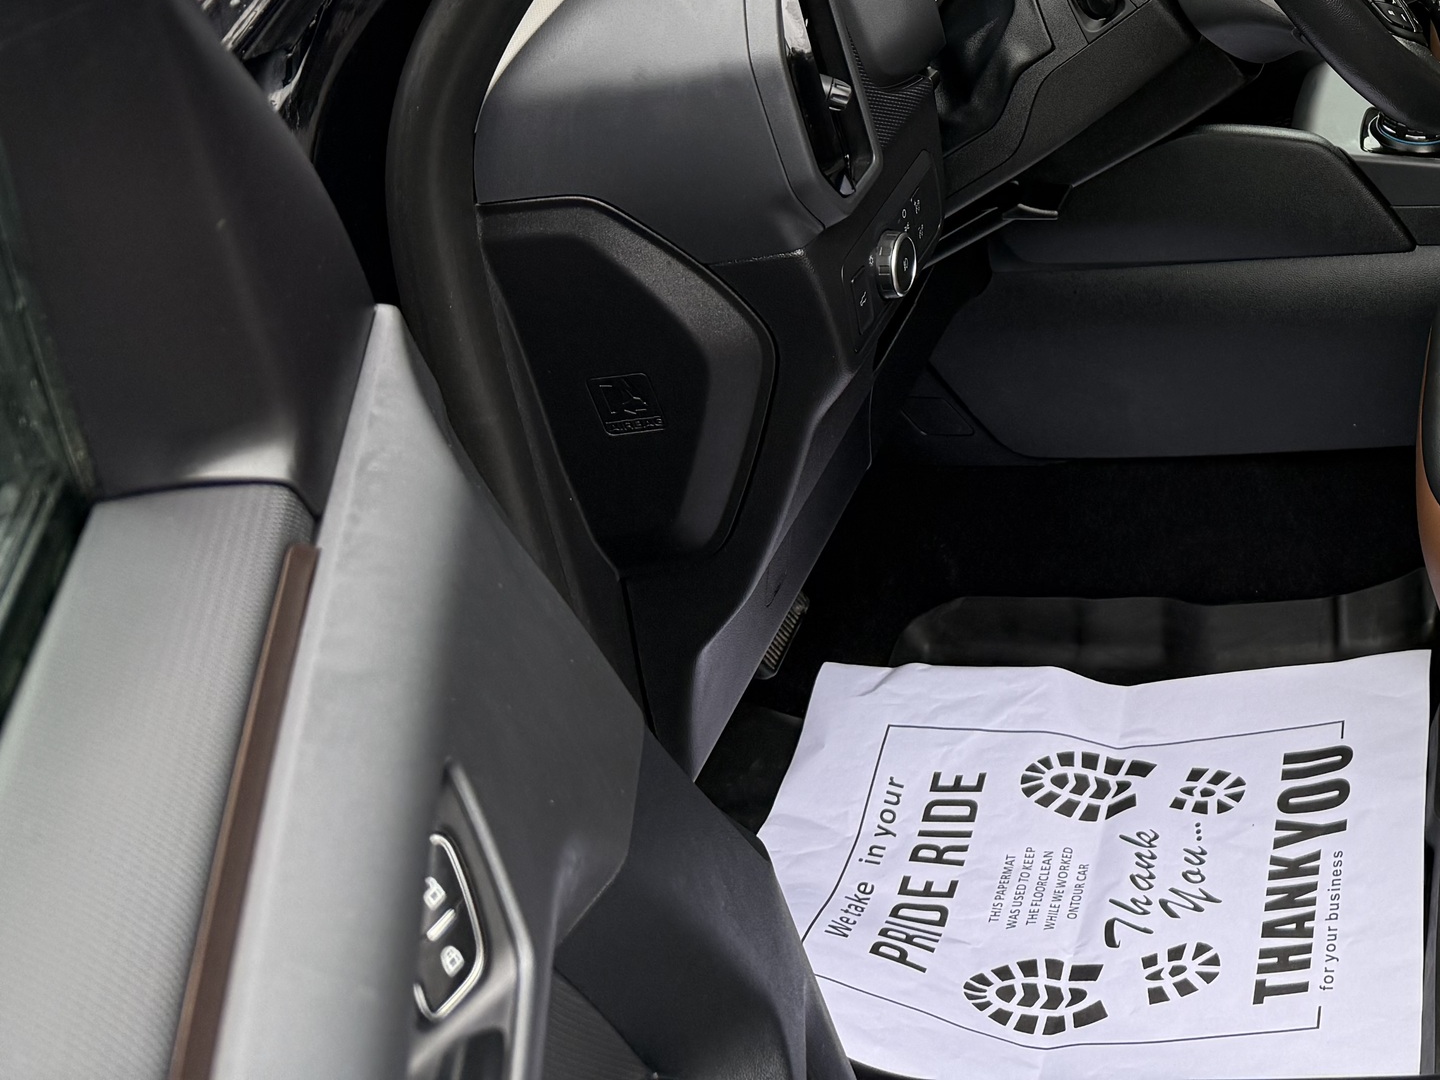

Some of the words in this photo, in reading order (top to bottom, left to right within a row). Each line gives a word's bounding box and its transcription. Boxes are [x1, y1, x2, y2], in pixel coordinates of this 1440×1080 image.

[610, 418, 663, 432] AIRBAG
[859, 845, 886, 865] in
[874, 777, 904, 837] your
[909, 772, 986, 866] RIDE
[1022, 847, 1035, 870] KEEP
[1018, 872, 1030, 882] TO
[1077, 864, 1090, 881] CAR
[1012, 885, 1026, 906] USED
[1105, 829, 1159, 948] Thank
[1325, 851, 1343, 920] business
[988, 903, 1003, 922] THIS
[1006, 909, 1020, 929] WAS
[1026, 909, 1039, 925] THE
[1044, 904, 1060, 930] WHILE
[869, 876, 958, 973] PRIDE
[1325, 926, 1339, 962] your
[1320, 967, 1334, 990] for
